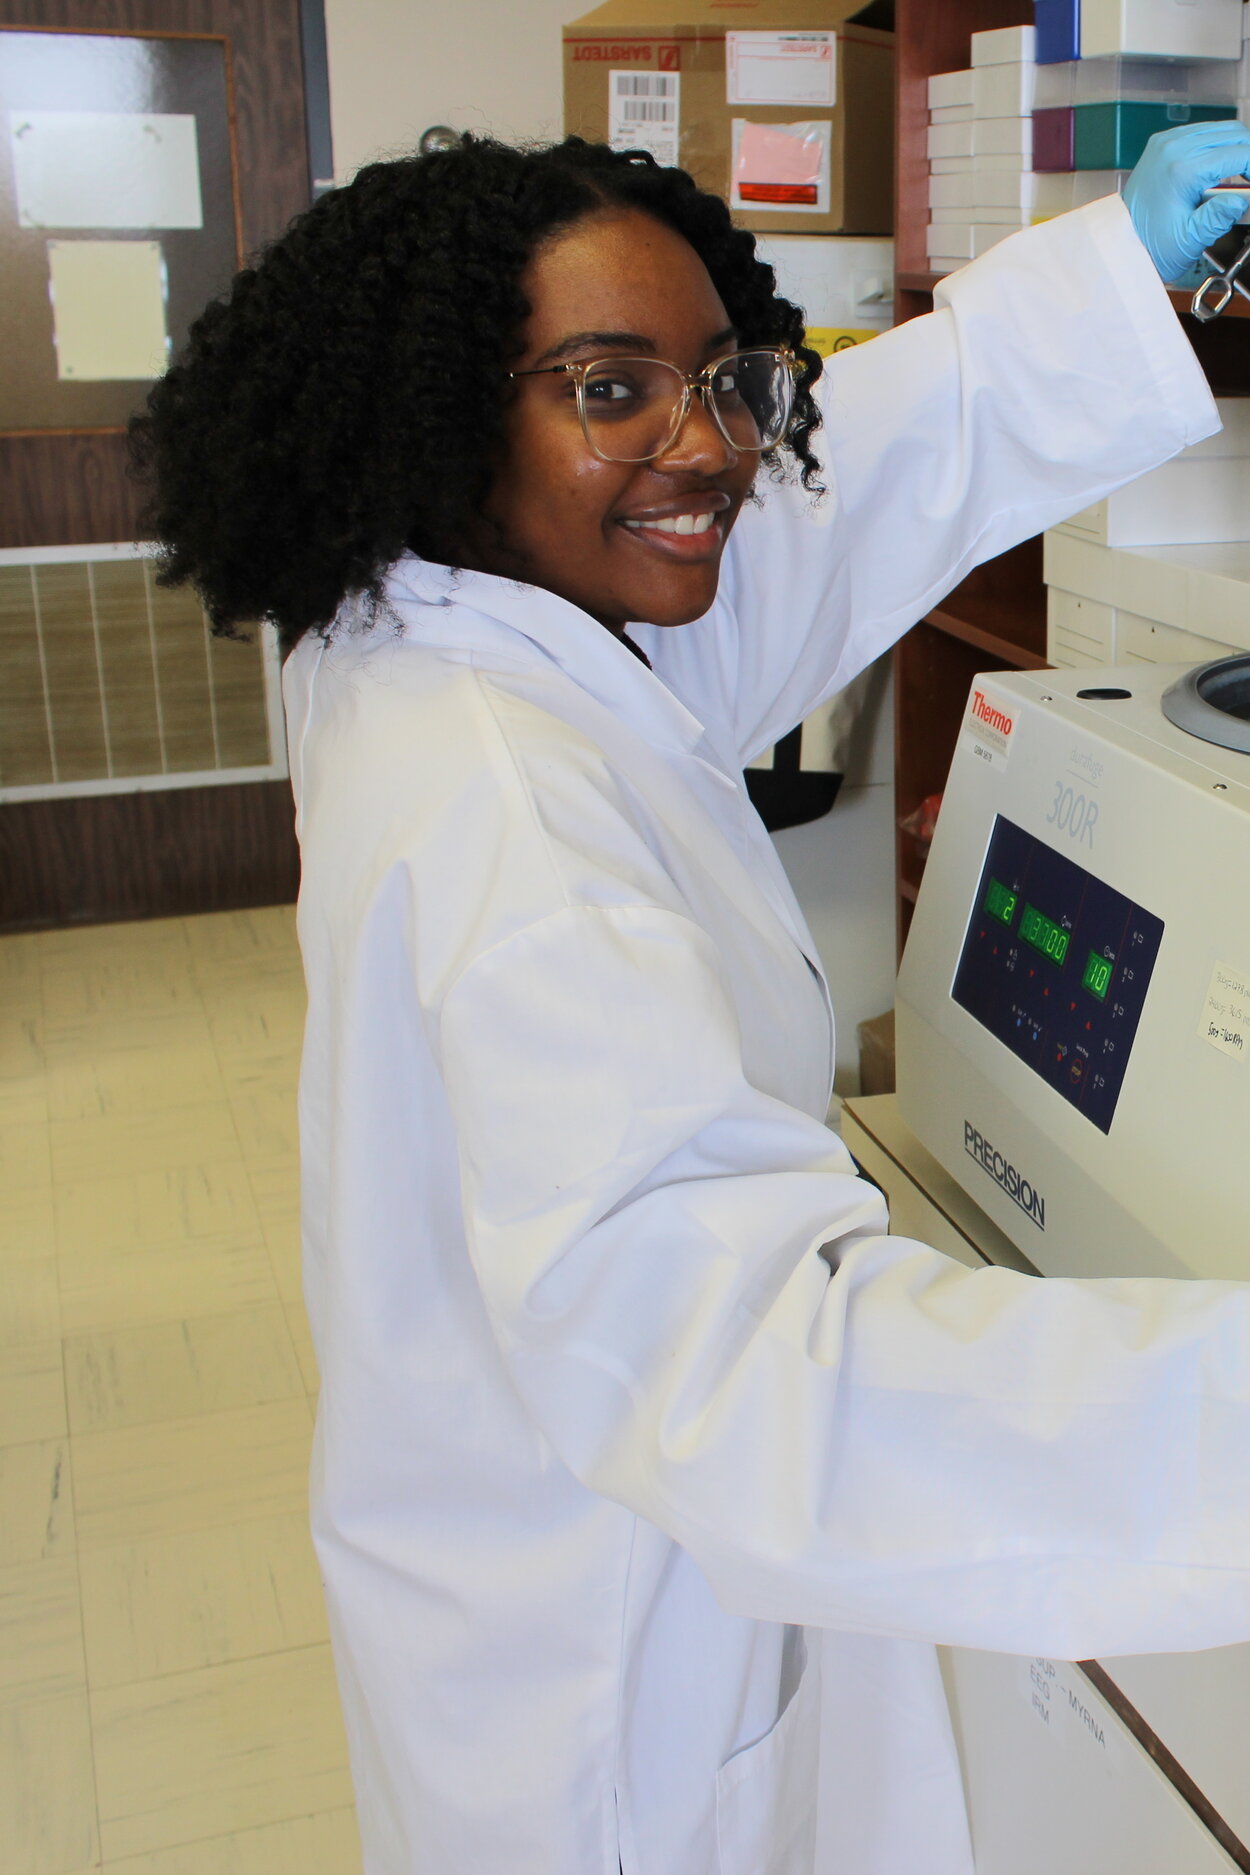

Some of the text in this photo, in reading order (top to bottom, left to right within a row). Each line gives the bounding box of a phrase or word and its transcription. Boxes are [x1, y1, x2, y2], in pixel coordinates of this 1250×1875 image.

[572, 44, 653, 61] SARSTEDT
[971, 690, 1012, 735] Thermo
[1047, 780, 1099, 849] 300R
[1004, 897, 1014, 920] 2
[1030, 917, 1067, 959] 3700
[1089, 963, 1108, 991] 10
[965, 1120, 1044, 1226] PRECISION
[1069, 1689, 1105, 1749] MYRNA
